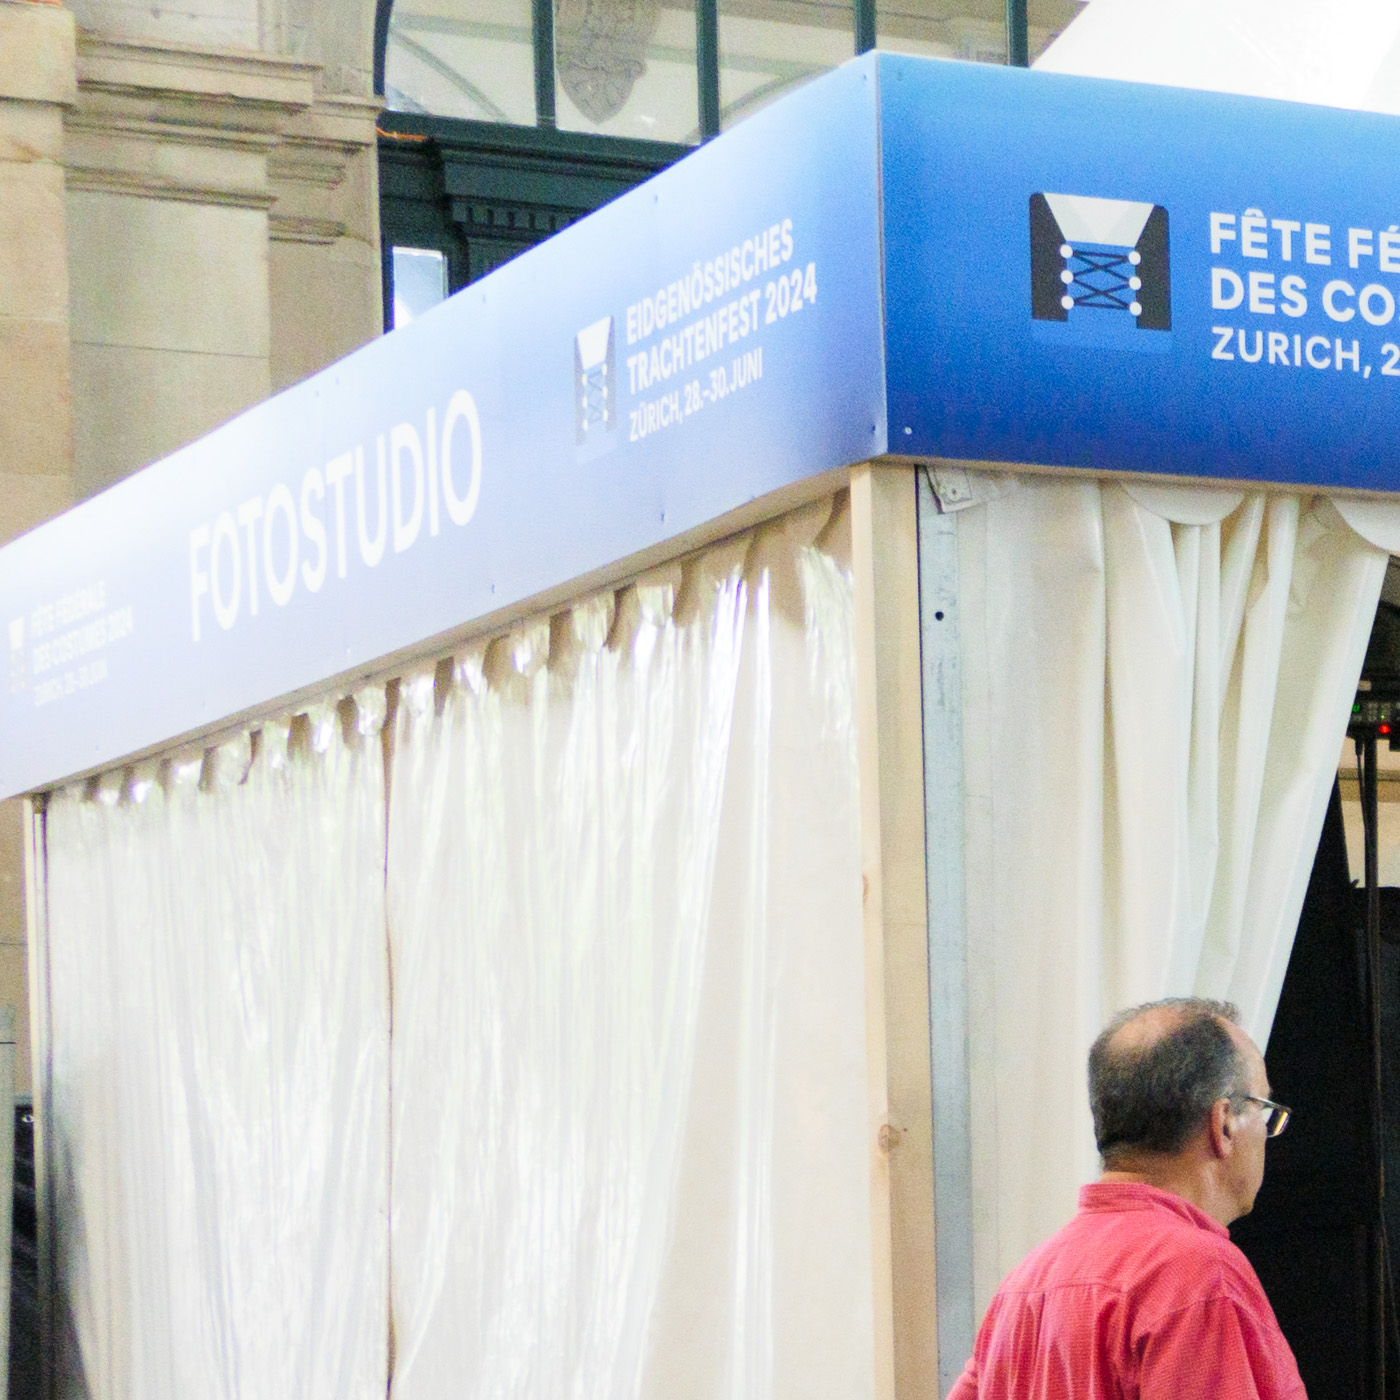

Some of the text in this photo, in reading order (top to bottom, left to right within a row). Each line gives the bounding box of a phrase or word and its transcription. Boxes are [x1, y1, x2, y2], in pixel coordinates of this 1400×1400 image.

[1209, 208, 1332, 266] FÊTE
[626, 217, 794, 346] EIDGENÖSSISCHES
[1211, 267, 1309, 318] DES
[626, 261, 818, 396] TRACHTENFEST 2024
[1211, 326, 1372, 379] ZURICH,
[629, 390, 683, 443] ZÜRICH,
[187, 387, 483, 644] FOTOSTUDIO
